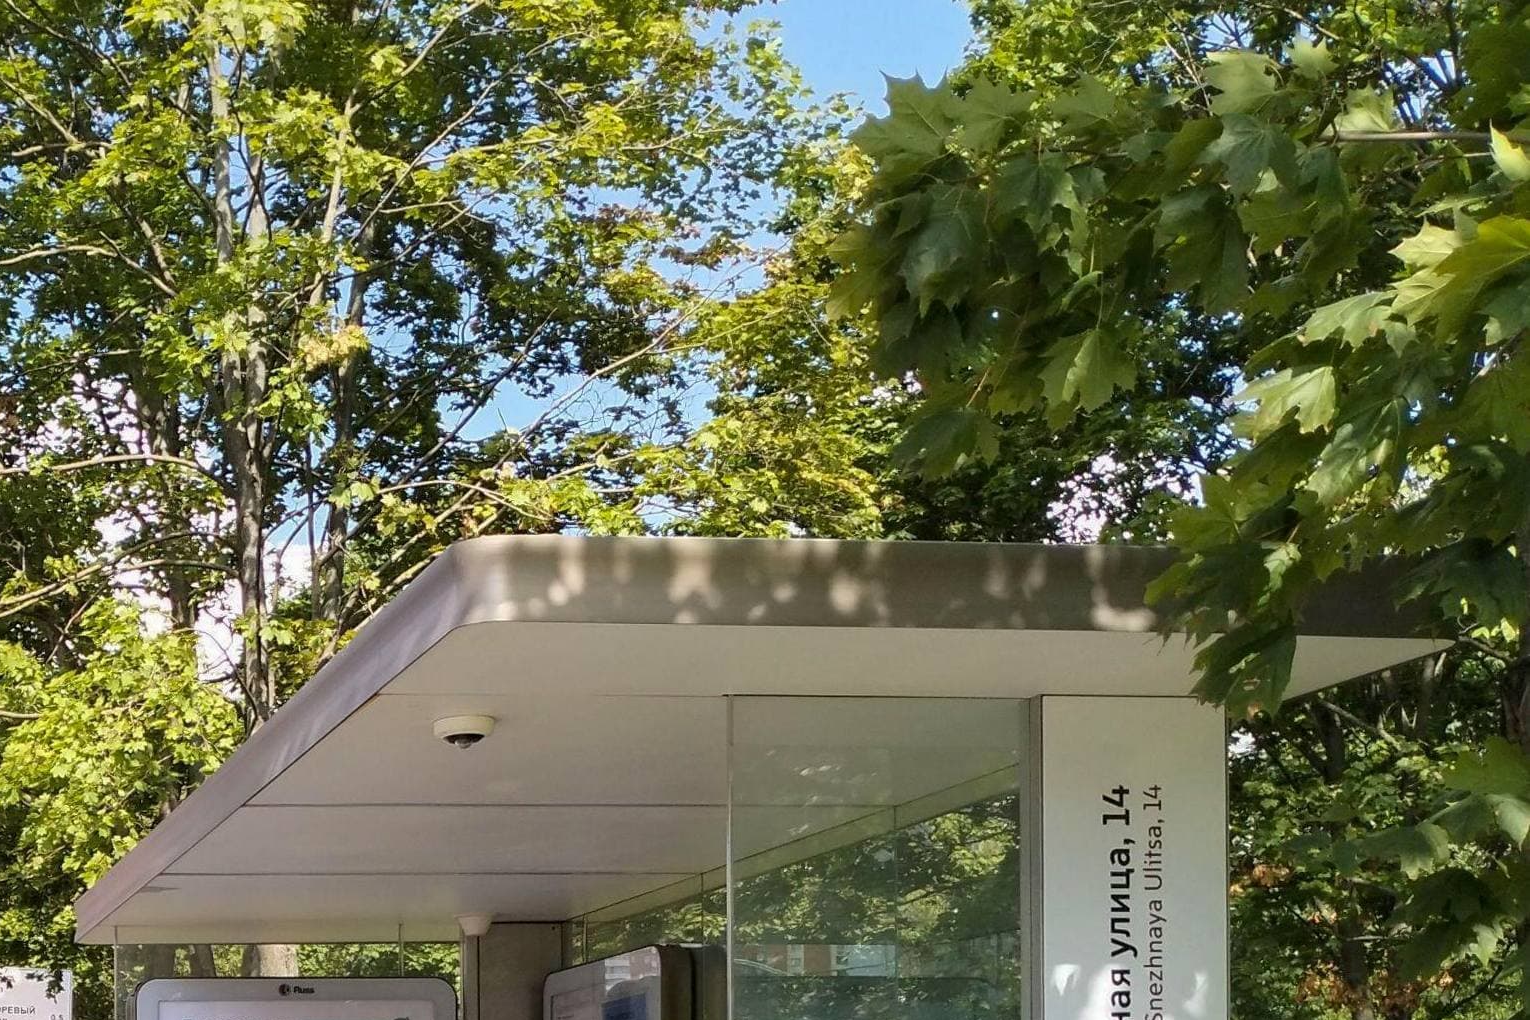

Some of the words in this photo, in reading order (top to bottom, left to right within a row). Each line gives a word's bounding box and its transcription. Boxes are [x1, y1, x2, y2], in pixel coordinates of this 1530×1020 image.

[1102, 784, 1130, 826] 14
[1143, 784, 1162, 811] 14
[1142, 818, 1165, 891] Ulitsa,
[1110, 837, 1138, 958] улица,
